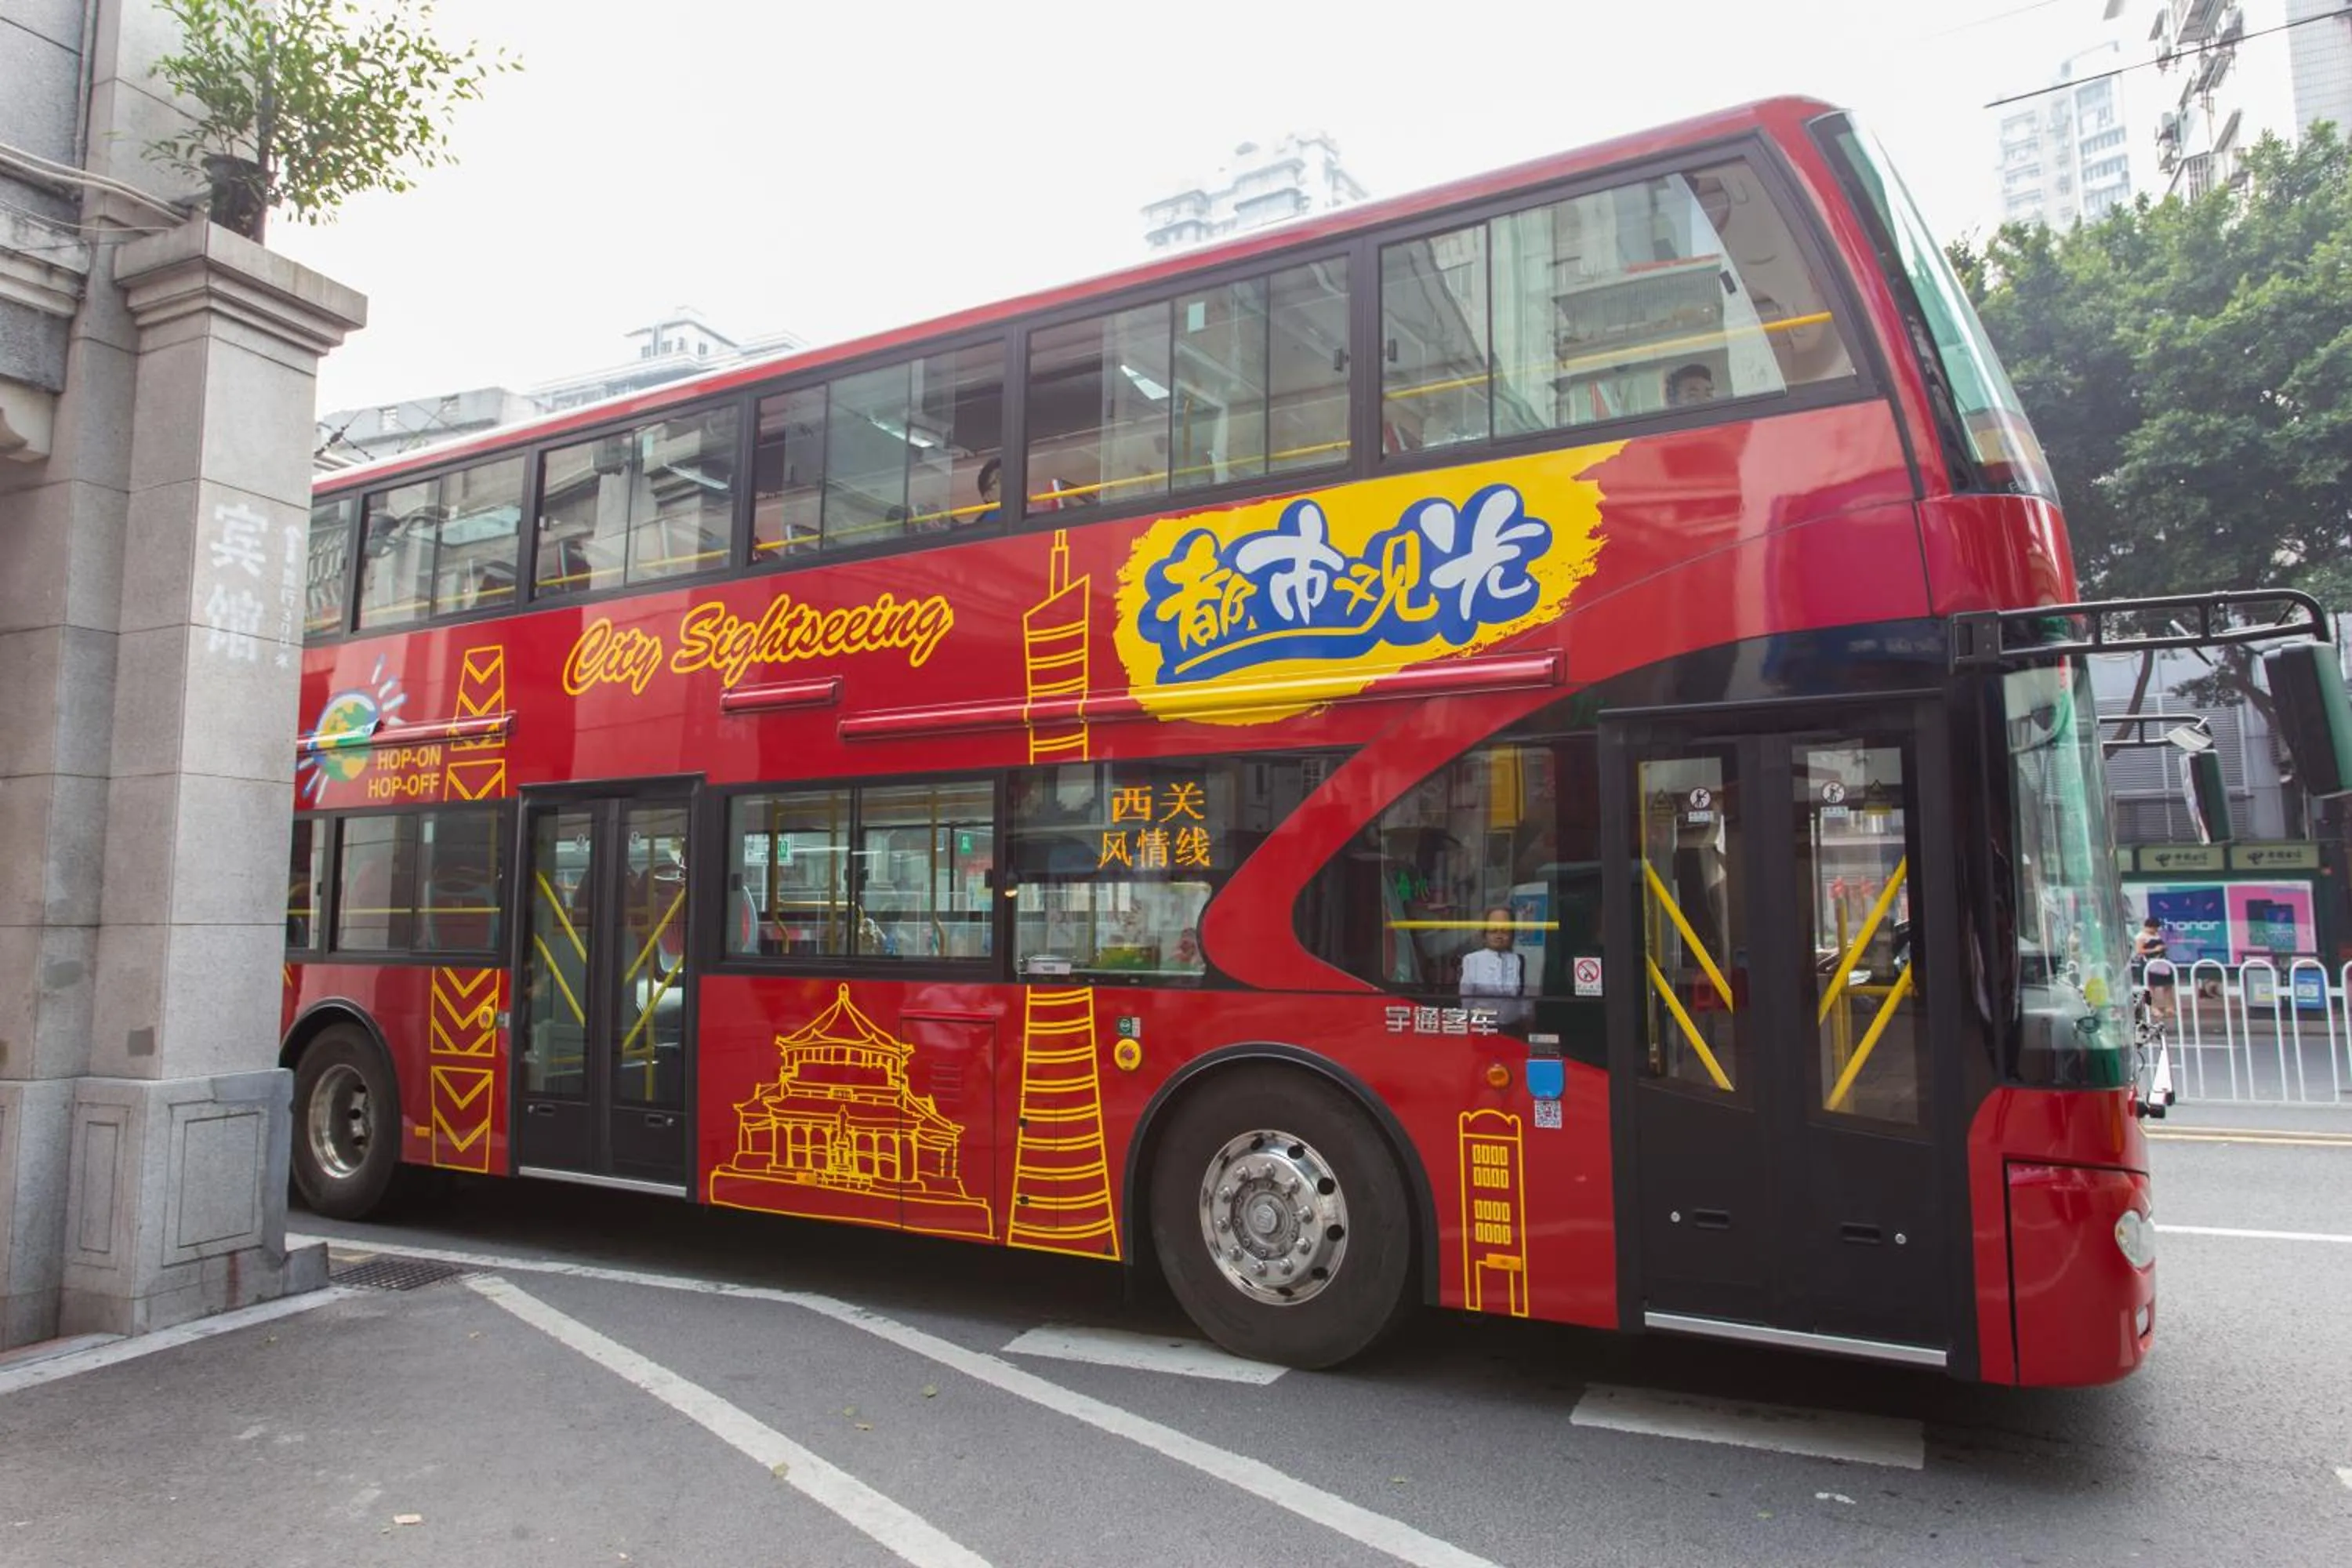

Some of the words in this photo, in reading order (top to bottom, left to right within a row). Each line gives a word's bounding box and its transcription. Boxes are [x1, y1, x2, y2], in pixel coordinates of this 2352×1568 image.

[1156, 489, 1545, 674] 都市观光
[562, 618, 662, 695] City
[670, 593, 953, 688] Sightseeing
[377, 746, 441, 771] HOP-ON
[368, 773, 440, 798] HOP-OFF
[1112, 782, 1205, 823] 西关
[1098, 826, 1210, 869] 风情线
[2164, 920, 2220, 931] honor
[1385, 1006, 1498, 1035] 宇通客车
